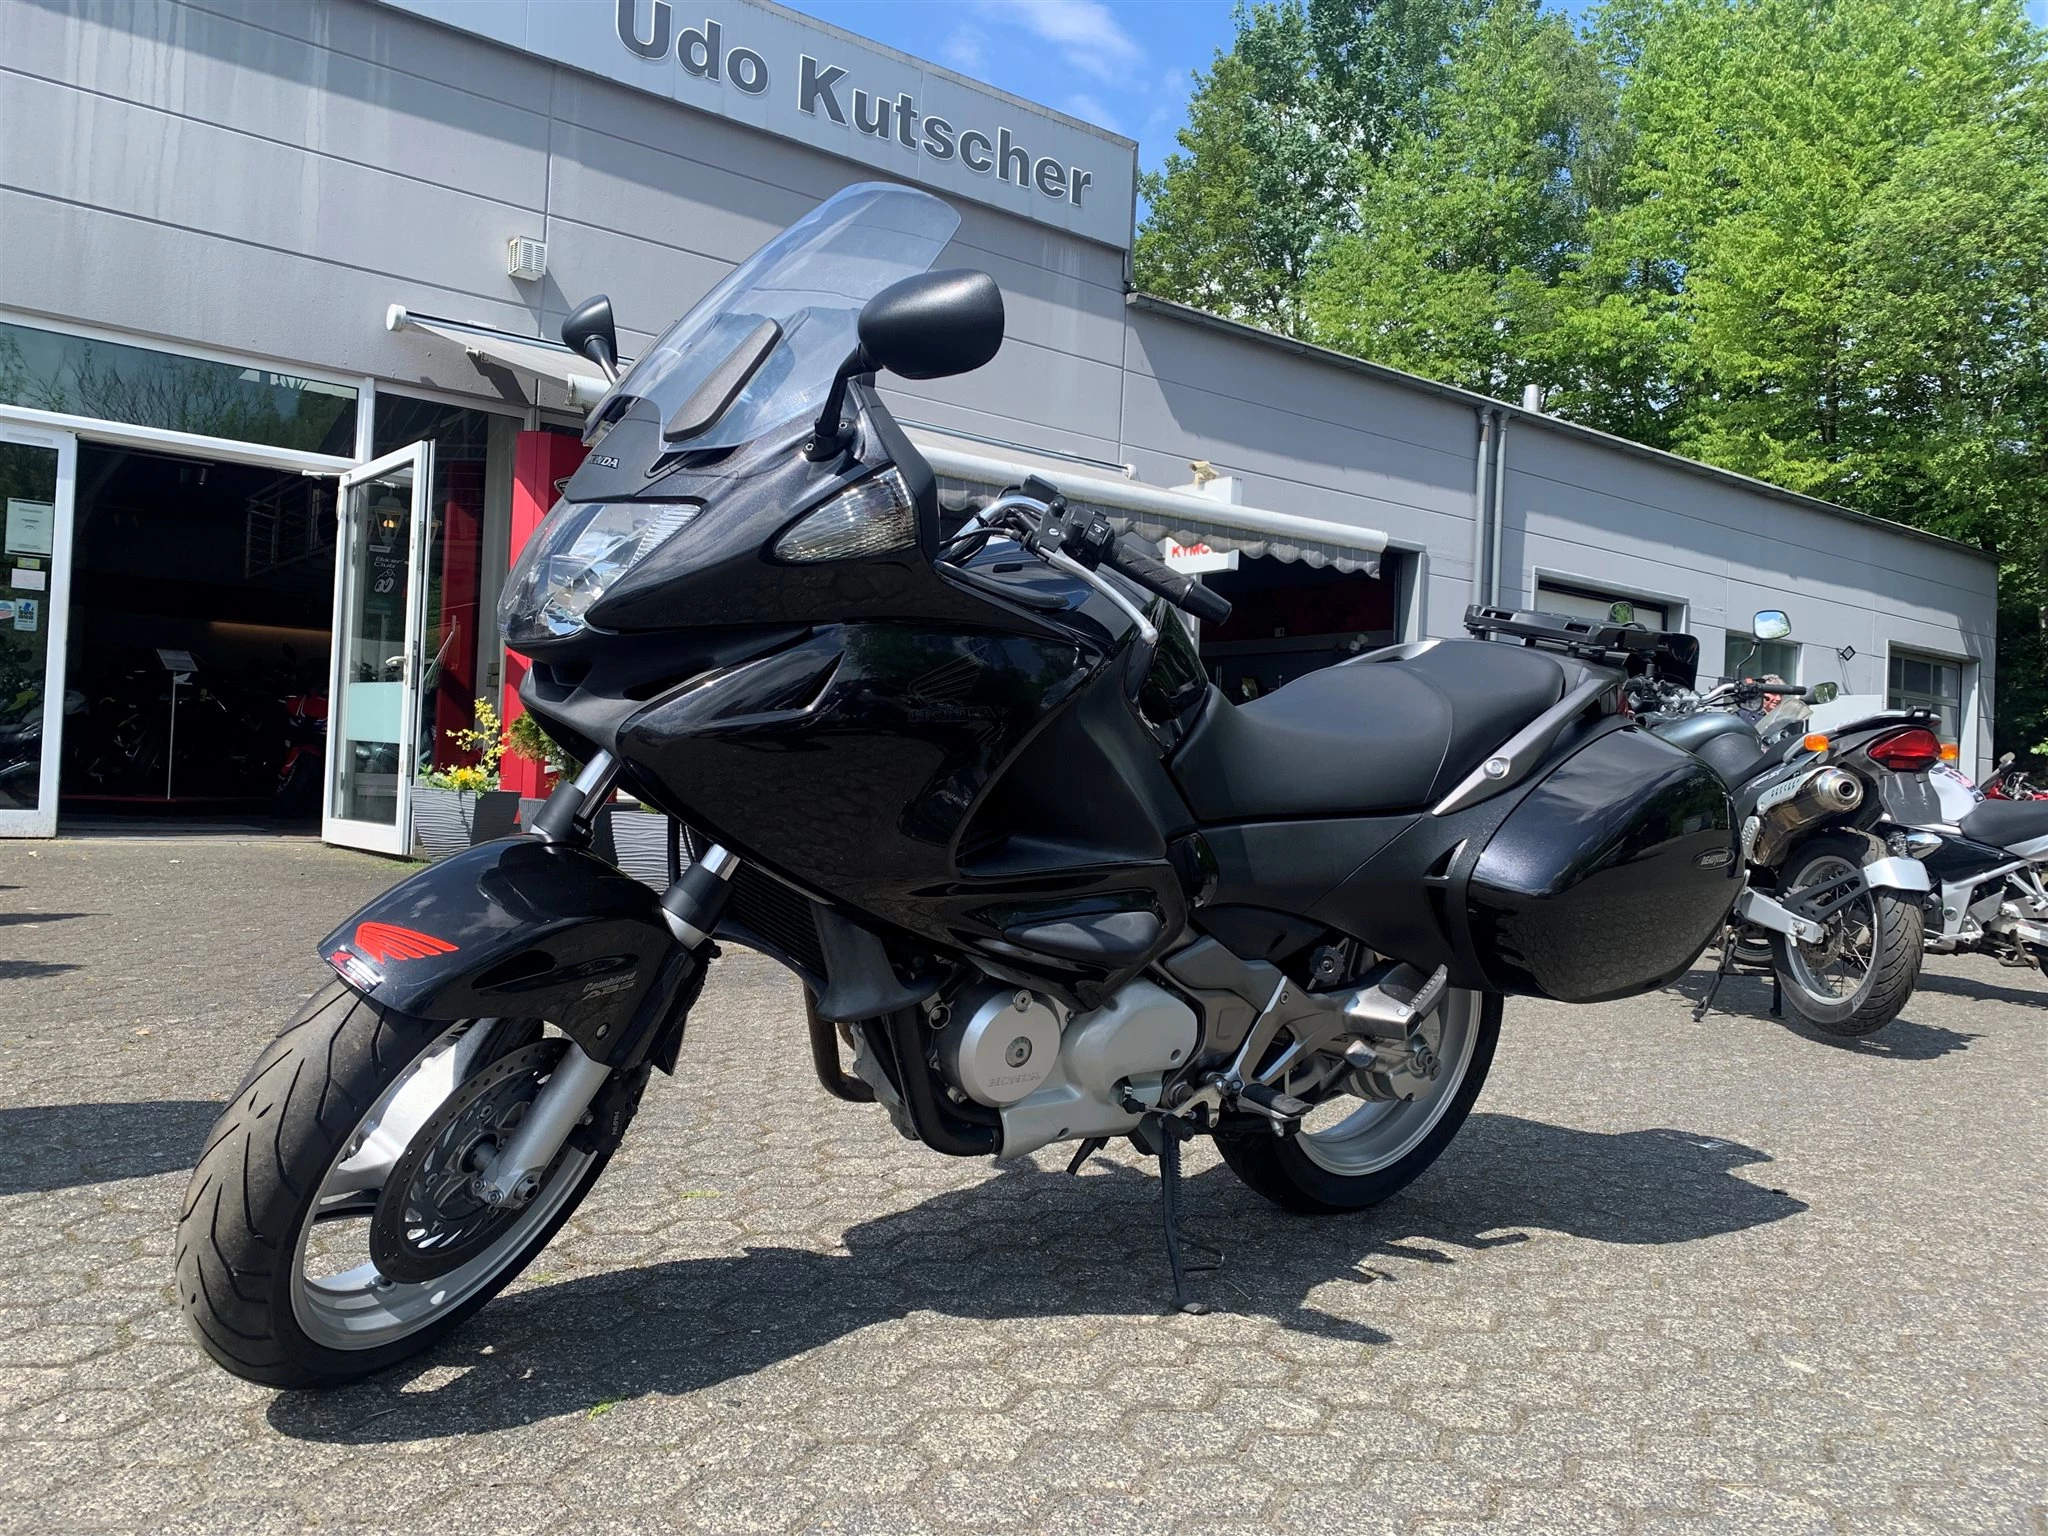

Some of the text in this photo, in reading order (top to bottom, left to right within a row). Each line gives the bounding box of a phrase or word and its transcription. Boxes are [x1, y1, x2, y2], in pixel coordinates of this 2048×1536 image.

[615, 0, 1093, 207] Udo Kutscher
[1171, 542, 1216, 558] KYMC
[986, 1071, 1041, 1087] HONDA
